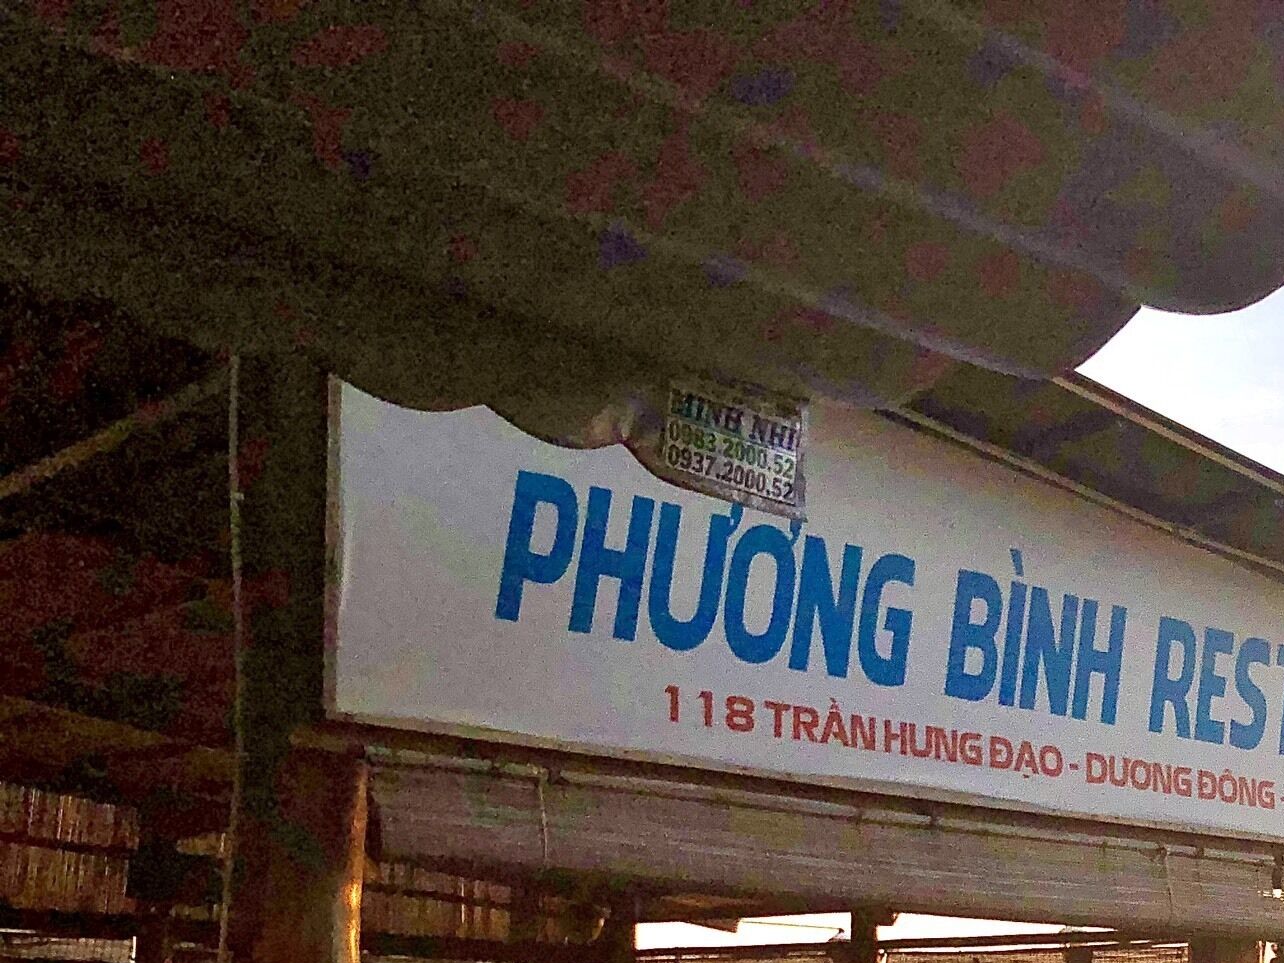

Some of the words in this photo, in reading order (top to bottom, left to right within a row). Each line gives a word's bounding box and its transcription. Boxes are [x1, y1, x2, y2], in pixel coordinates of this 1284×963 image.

[667, 443, 795, 500] 0937.2000.52
[495, 470, 916, 688] PHƯƠNG
[944, 548, 1127, 725] BÌNH
[664, 684, 755, 733] 118
[988, 735, 1064, 779] ĐẠO
[1197, 768, 1276, 810] ĐÔNG
